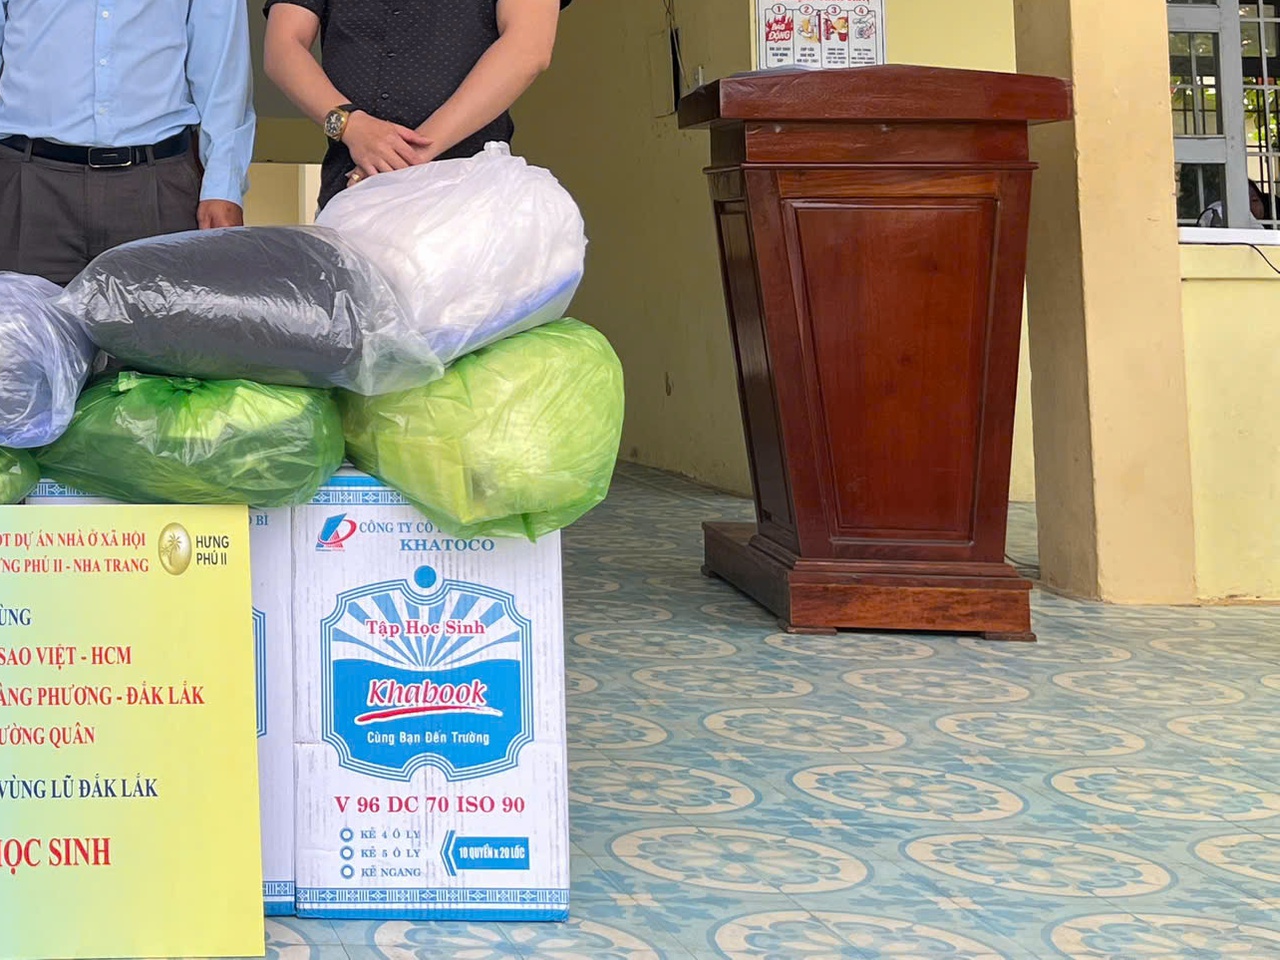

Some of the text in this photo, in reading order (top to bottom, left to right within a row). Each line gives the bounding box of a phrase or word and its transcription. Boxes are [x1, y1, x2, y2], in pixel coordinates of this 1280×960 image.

[14, 530, 33, 551] DỰ
[36, 530, 54, 547] ÁN
[57, 529, 85, 547] NHÀ
[87, 529, 100, 547] Ở
[101, 530, 118, 547] XÃ
[122, 530, 146, 549] HỘI
[195, 534, 229, 549] HƯNG
[400, 538, 495, 552] KHATOCO
[24, 555, 50, 573] PHÚ
[53, 559, 63, 573] II
[73, 558, 101, 573] NHA
[104, 558, 149, 573] TRANG
[196, 550, 227, 566] PHÚ II
[366, 619, 486, 638] Tập Học Sinh
[36, 644, 76, 670] VIỆT
[91, 646, 132, 665] HCM
[37, 685, 112, 706] PHƯƠNG
[126, 681, 164, 705] ĐẮK
[168, 681, 205, 705] LẮK
[368, 680, 486, 705] Khabook
[49, 722, 95, 749] QUÂN
[367, 729, 490, 745] Cùng Bạn Đến Trường
[51, 775, 74, 799] LŨ
[79, 773, 117, 798] ĐẮK
[121, 773, 159, 798] LẮK
[334, 796, 525, 813] V 96 DC 70 ISO 90
[48, 837, 111, 867] SINH
